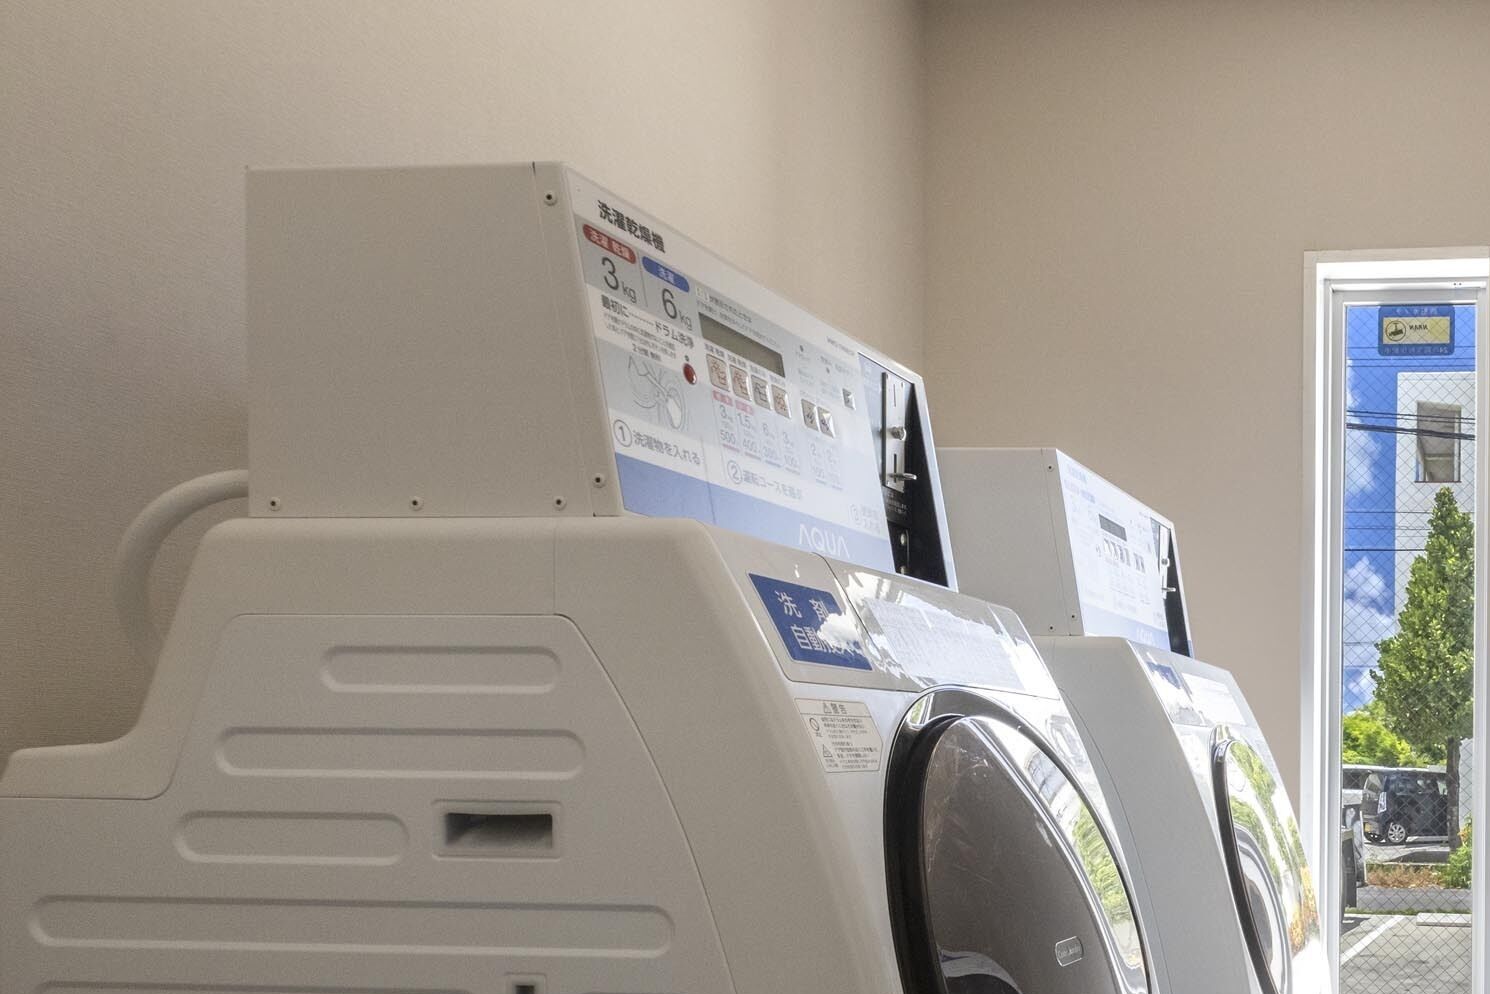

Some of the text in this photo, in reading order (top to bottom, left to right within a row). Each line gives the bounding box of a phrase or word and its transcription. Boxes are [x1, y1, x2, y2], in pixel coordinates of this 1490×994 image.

[602, 257, 637, 304] 3 kg
[662, 288, 677, 319] 6
[800, 523, 850, 559] AQUA
